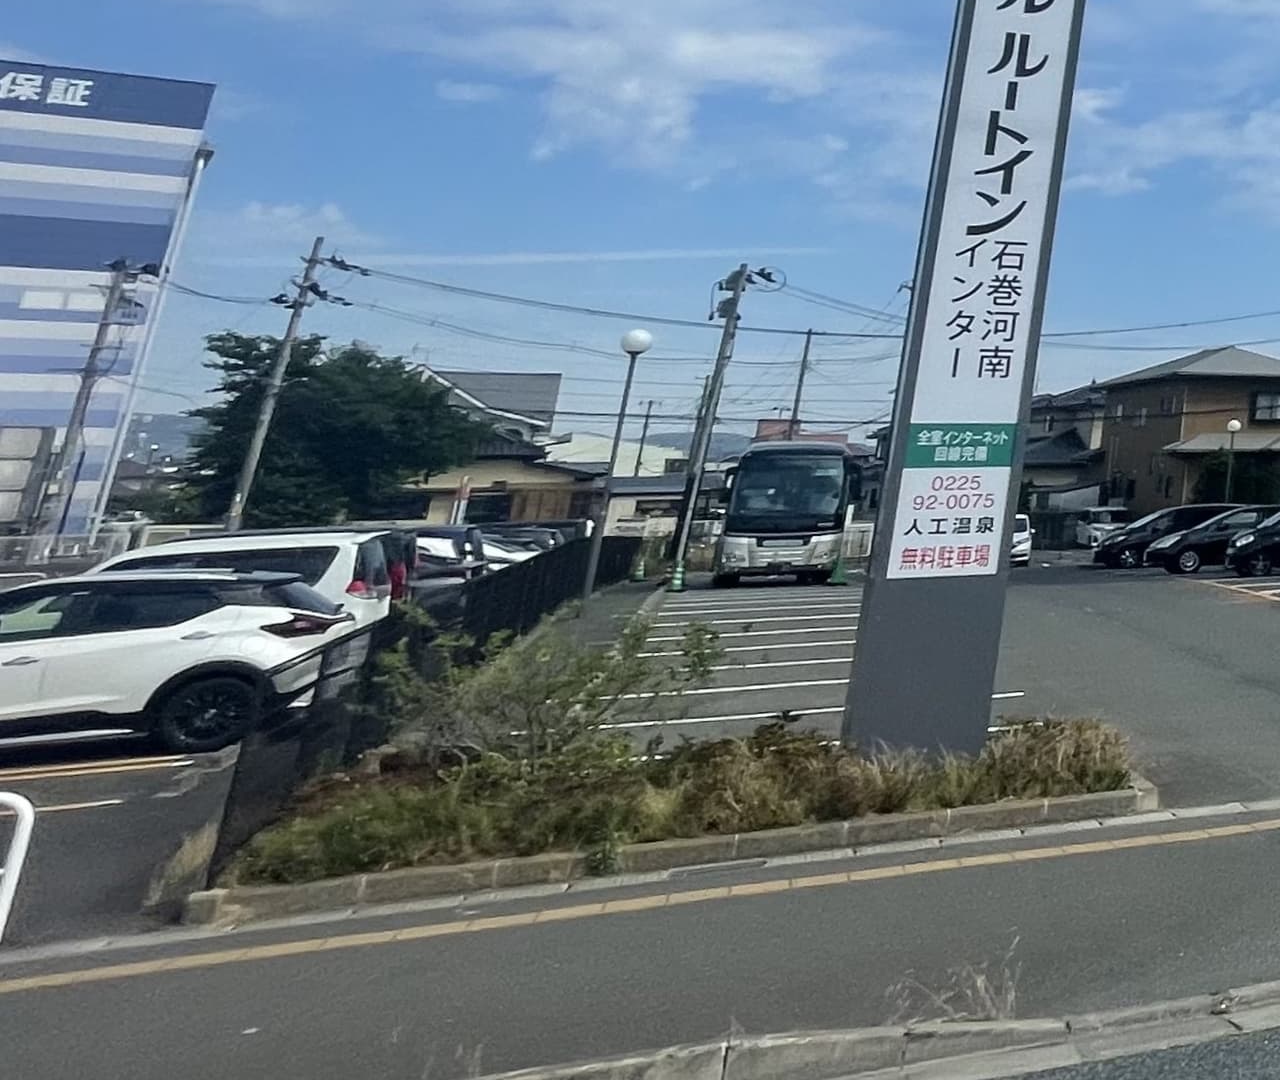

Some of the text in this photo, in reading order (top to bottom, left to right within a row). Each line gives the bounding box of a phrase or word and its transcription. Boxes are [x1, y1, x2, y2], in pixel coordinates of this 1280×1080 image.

[0, 71, 95, 107] 保証
[966, 31, 1049, 237] ルートイン
[945, 238, 989, 378] インター
[976, 240, 1028, 379] 石巻河南
[916, 429, 1009, 446] 全室インターネット
[933, 445, 989, 462] 回線完備
[931, 475, 982, 492] 0225
[912, 493, 995, 511] 92-0075
[903, 516, 995, 536] 人工温泉
[899, 544, 991, 570] 無料駐車場
